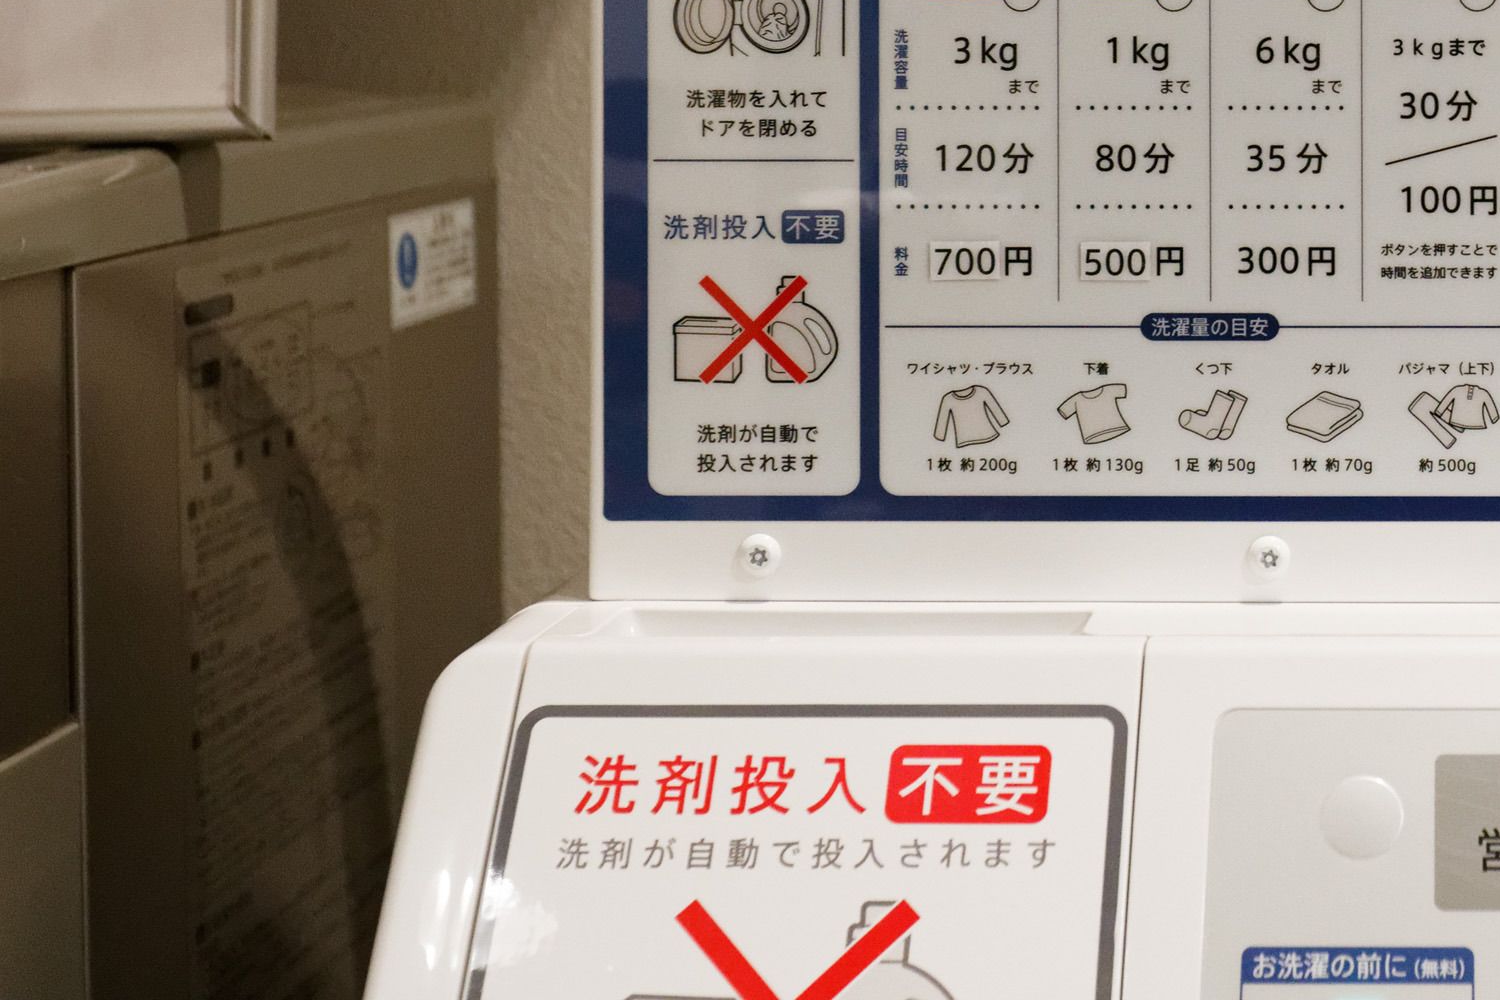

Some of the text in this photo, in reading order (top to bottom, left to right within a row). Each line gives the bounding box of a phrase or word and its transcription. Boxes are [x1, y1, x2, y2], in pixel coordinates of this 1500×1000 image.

[1009, 80, 1038, 94] まで
[1161, 80, 1189, 94] まで
[1312, 80, 1341, 94] まで
[687, 90, 826, 108] 洗濯物を入れて
[703, 119, 816, 137] ドアを閉める
[664, 215, 840, 240] 洗剤投入 不要
[1382, 244, 1497, 256] ボタンを押すことで
[1381, 267, 1496, 279] 時間を追加できます
[1151, 317, 1269, 337] 洗濯量の目安
[1084, 363, 1109, 375] 下着
[1196, 363, 1232, 375] くつ下
[1312, 363, 1349, 375] タオル
[698, 425, 817, 443] 洗剤が自動で
[698, 454, 817, 472] 投入されます
[575, 755, 1041, 817] 洗剤投入 不要
[557, 838, 1055, 869] 洗剤が自動で投入されます
[1252, 953, 1406, 980] お洗濯の前に
